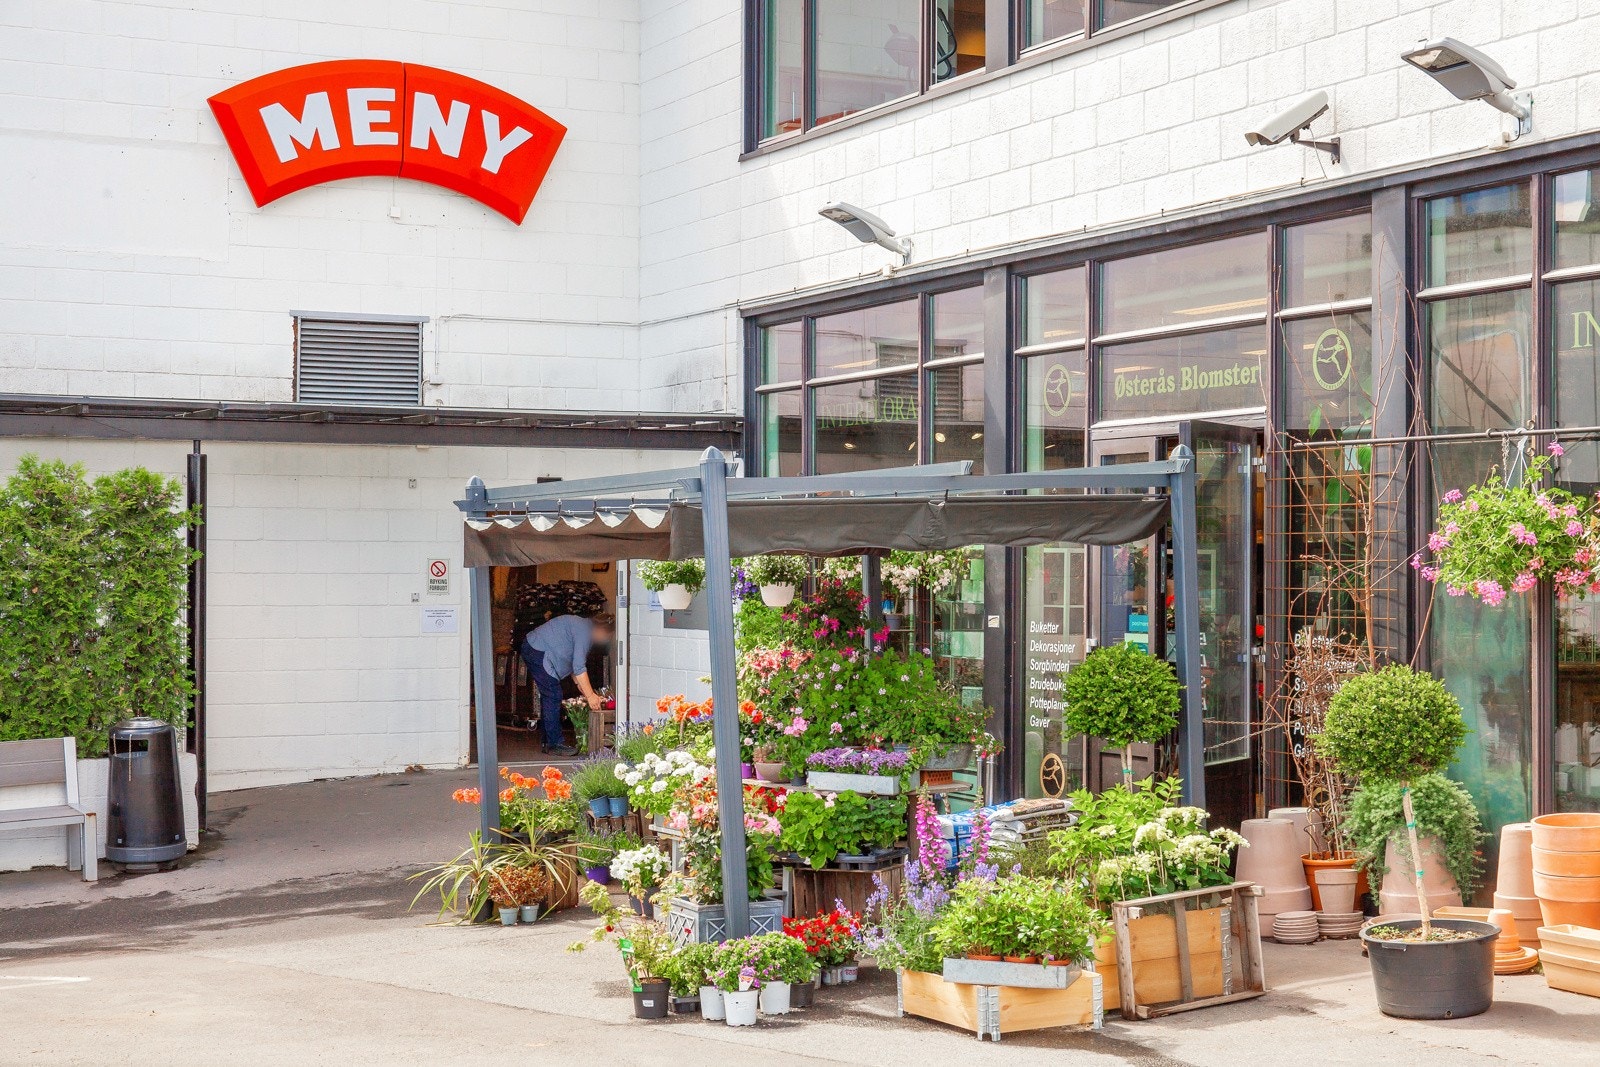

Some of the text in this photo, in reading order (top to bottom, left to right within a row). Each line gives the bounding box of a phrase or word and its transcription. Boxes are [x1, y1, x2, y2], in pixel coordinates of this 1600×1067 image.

[259, 88, 533, 174] MENY
[1114, 363, 1260, 400] Østerås Blomster
[821, 395, 918, 429] INTERFLORA
[1030, 620, 1059, 634] Buketter
[1030, 640, 1075, 656] Dekorasjoner
[1030, 658, 1070, 674] Sorgbinderi
[1030, 715, 1051, 728] Gaver
